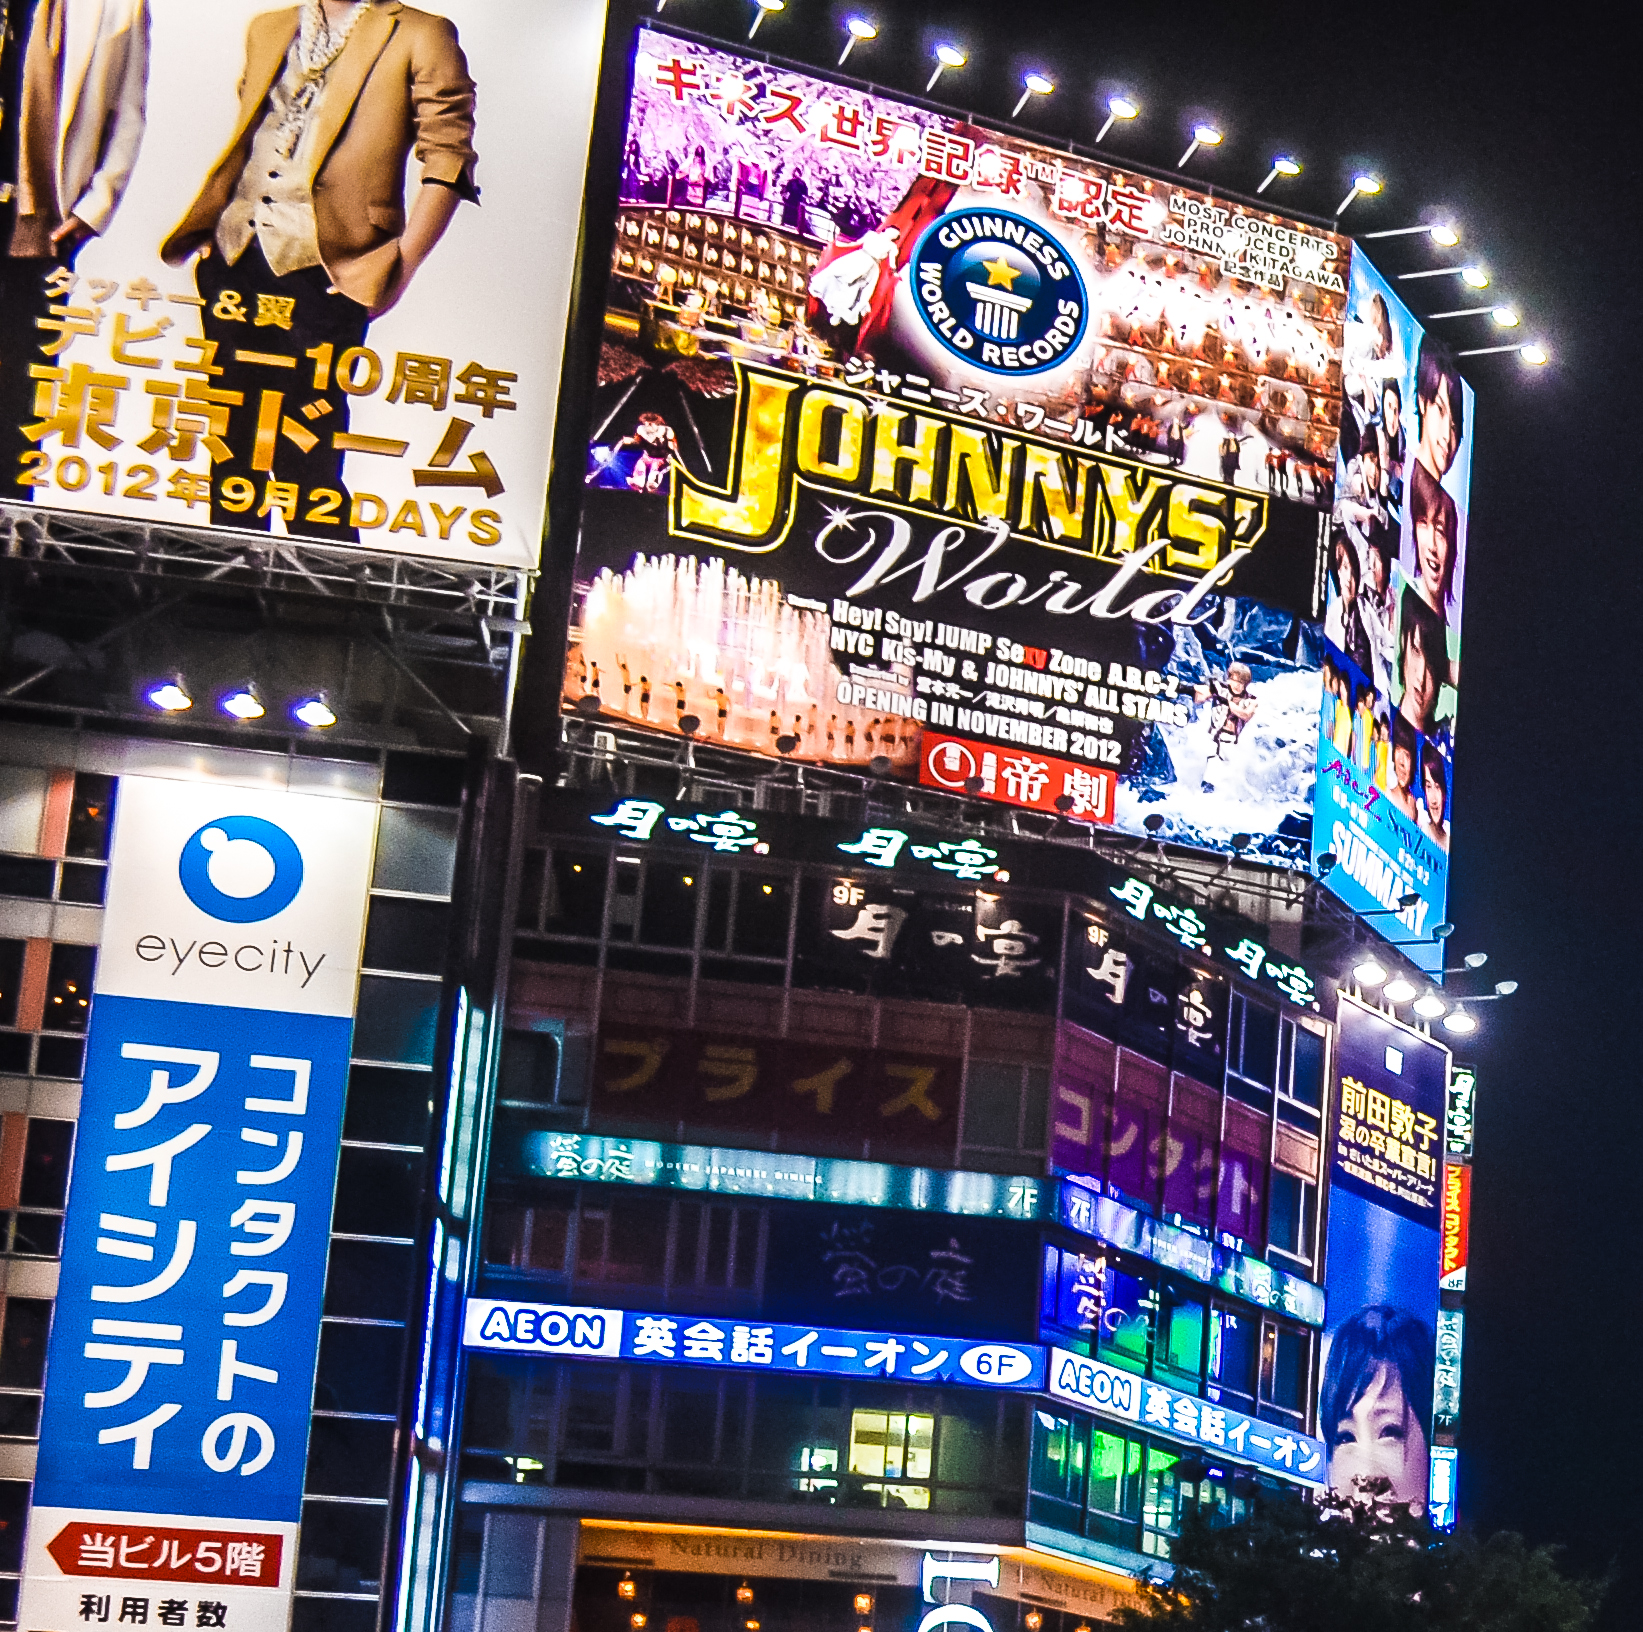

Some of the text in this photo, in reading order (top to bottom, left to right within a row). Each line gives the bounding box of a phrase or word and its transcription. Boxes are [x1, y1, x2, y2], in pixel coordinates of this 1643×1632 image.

[938, 215, 1070, 281] GUINNESS
[1172, 197, 1337, 257] MOST CONCERTS
[919, 261, 1080, 368] WORLD RECORDS
[33, 303, 519, 419] デビュー10周年
[19, 363, 506, 500] 東京ドーム
[16, 451, 503, 548] 2012年9月2DAYS
[815, 510, 1252, 626] World
[833, 599, 882, 634] Hey!
[934, 621, 992, 657] JUMP
[1049, 648, 1102, 681] Zone
[831, 627, 875, 658] NYC
[882, 638, 956, 675] Kis-My
[962, 659, 979, 682] &
[1088, 685, 1120, 714] ALL
[1121, 693, 1190, 729] STARS
[837, 680, 1123, 765] OPENING IN NOVEMBER 2012
[1001, 754, 1108, 818] 帝劇
[832, 886, 866, 907] 9F
[135, 933, 326, 988] eyecity
[1087, 926, 1109, 948] 9F
[602, 1038, 944, 1122] プライス
[1341, 1076, 1439, 1151] 前田敦子
[1008, 1185, 1038, 1218] 7F
[1070, 1196, 1091, 1223] 7F
[83, 1041, 221, 1471] アイシティ
[201, 1054, 313, 1478] コンタクトの
[481, 1307, 1018, 1377] AEON 英会話イーオン 6F
[1058, 1357, 1324, 1474] AEON 英会話イーオン
[1437, 1414, 1453, 1427] 7F
[77, 1530, 266, 1577] 当ビル5階
[80, 1592, 228, 1629] 利用者数
